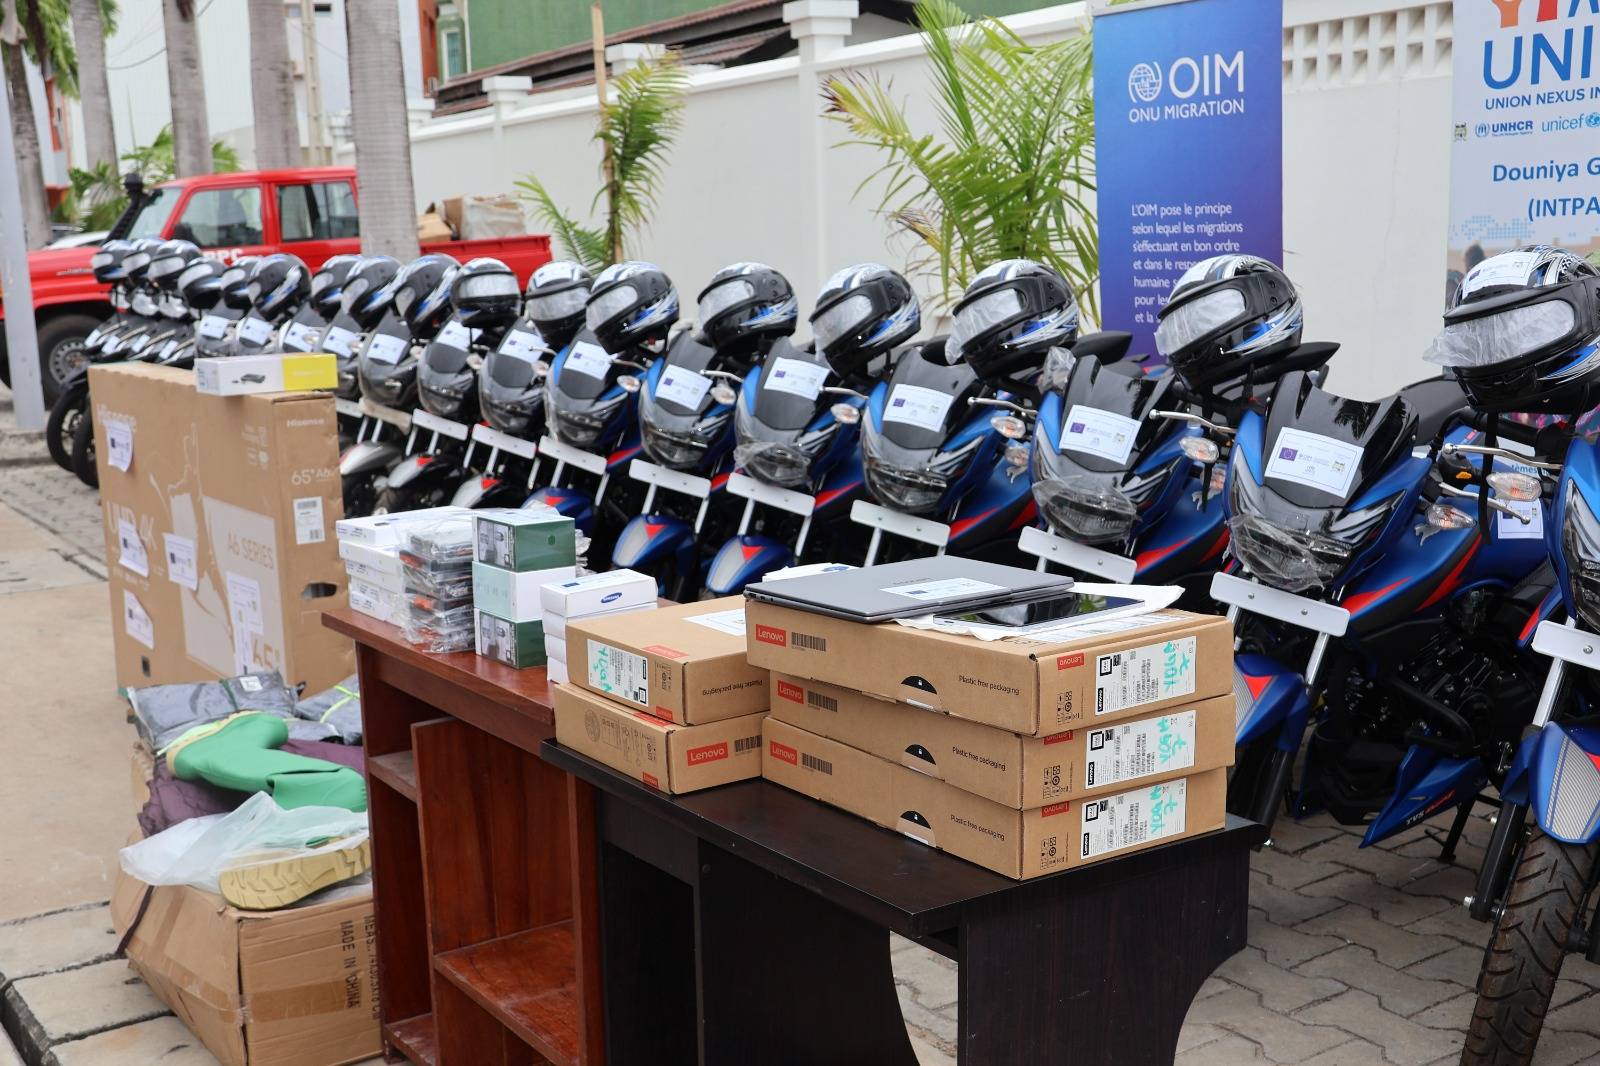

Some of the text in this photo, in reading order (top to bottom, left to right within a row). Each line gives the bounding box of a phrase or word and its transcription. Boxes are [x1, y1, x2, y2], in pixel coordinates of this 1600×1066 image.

[1483, 25, 1594, 90] UNI
[1168, 50, 1244, 99] OIM
[1485, 94, 1531, 110] UNION
[1536, 88, 1585, 105] NEXUS
[1128, 98, 1244, 123] ONU MIGRATION
[1491, 120, 1534, 133] UNHCR
[1541, 113, 1585, 132] unicef
[1492, 159, 1579, 182] Douniya
[1131, 202, 1232, 219] L'OIM pose le principe
[1528, 196, 1600, 222] (INTPA
[1132, 221, 1243, 237] selon lequel les migrations
[1180, 242, 1191, 251] en
[1194, 239, 1211, 251] bon
[1214, 239, 1240, 251] ordre
[1133, 260, 1141, 270] et
[1143, 258, 1162, 270] dans
[1165, 258, 1172, 269] le
[1133, 276, 1171, 288] humaine
[1134, 296, 1156, 308] pour
[1134, 311, 1154, 323] et la
[242, 538, 274, 570] SERIES
[758, 627, 784, 642] Lenovo
[1059, 655, 1083, 666] Lenovo
[779, 684, 803, 699] Lenovo
[958, 674, 1020, 696] Plastic free packaging
[690, 747, 725, 762] Lenovo
[772, 745, 796, 761] Lenovo
[952, 746, 1006, 772] Plastic free packaging
[950, 814, 1005, 841] Plastic free packaging
[340, 920, 360, 1009] MADE IN CHINA
